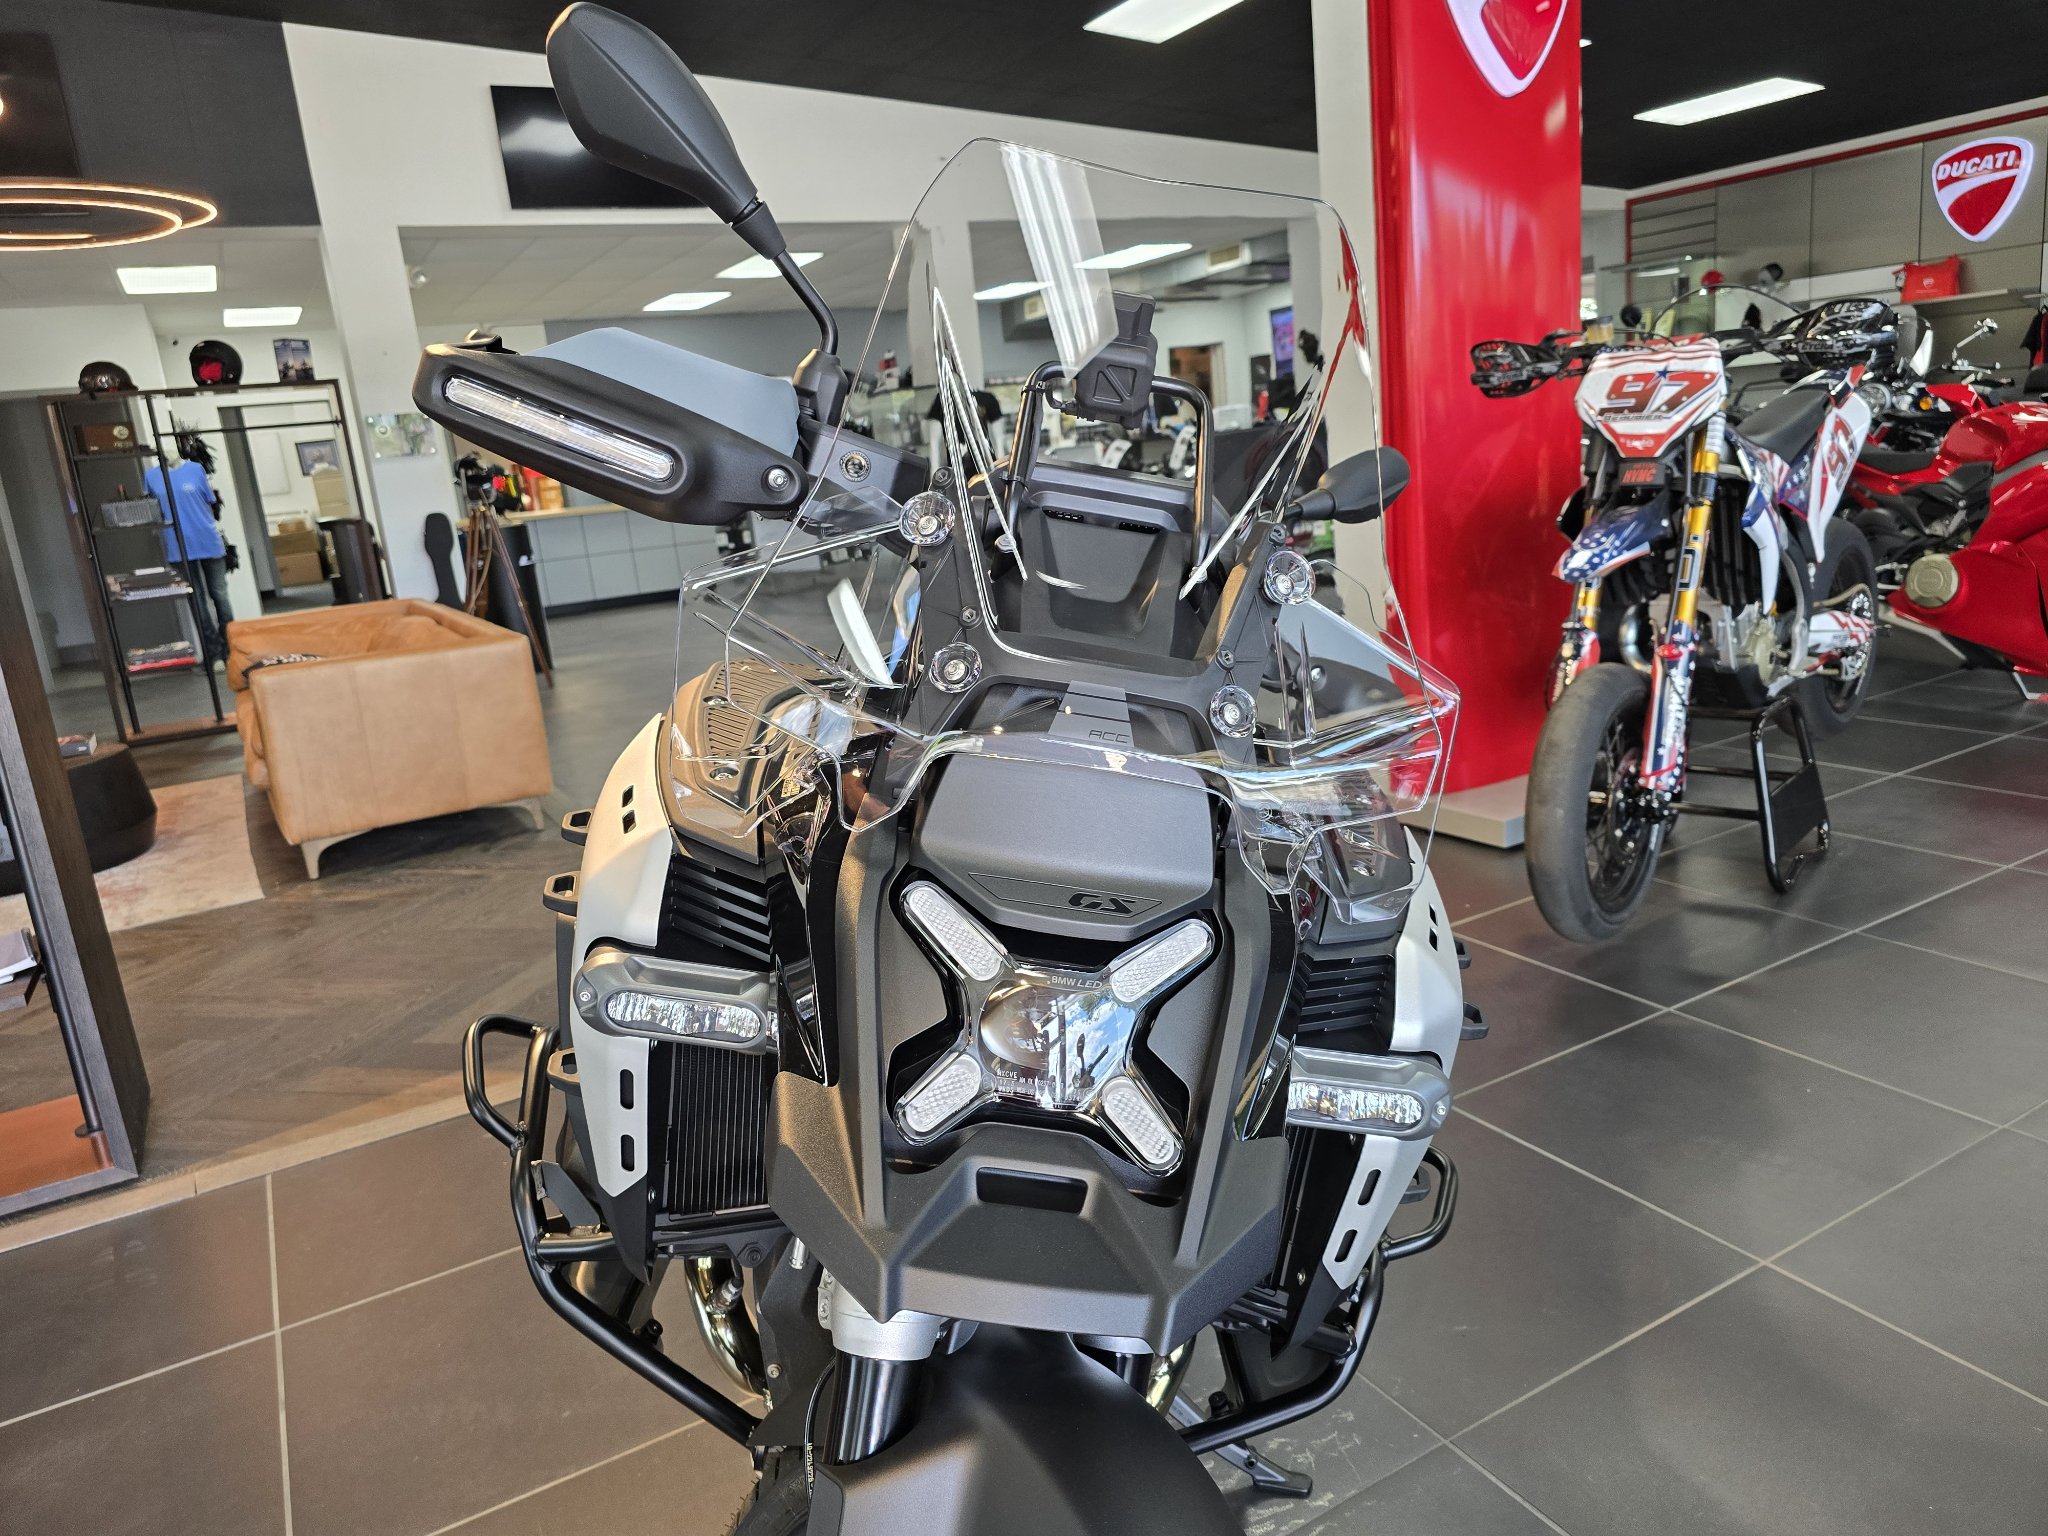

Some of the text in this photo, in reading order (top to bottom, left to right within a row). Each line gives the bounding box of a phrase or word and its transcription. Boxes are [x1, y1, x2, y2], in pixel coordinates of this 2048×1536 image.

[1937, 150, 2016, 180] DUCATI
[1598, 371, 1720, 415] 97
[1088, 729, 1130, 743] ACC
[1068, 891, 1136, 914] GS
[1051, 975, 1102, 989] BMW LED
